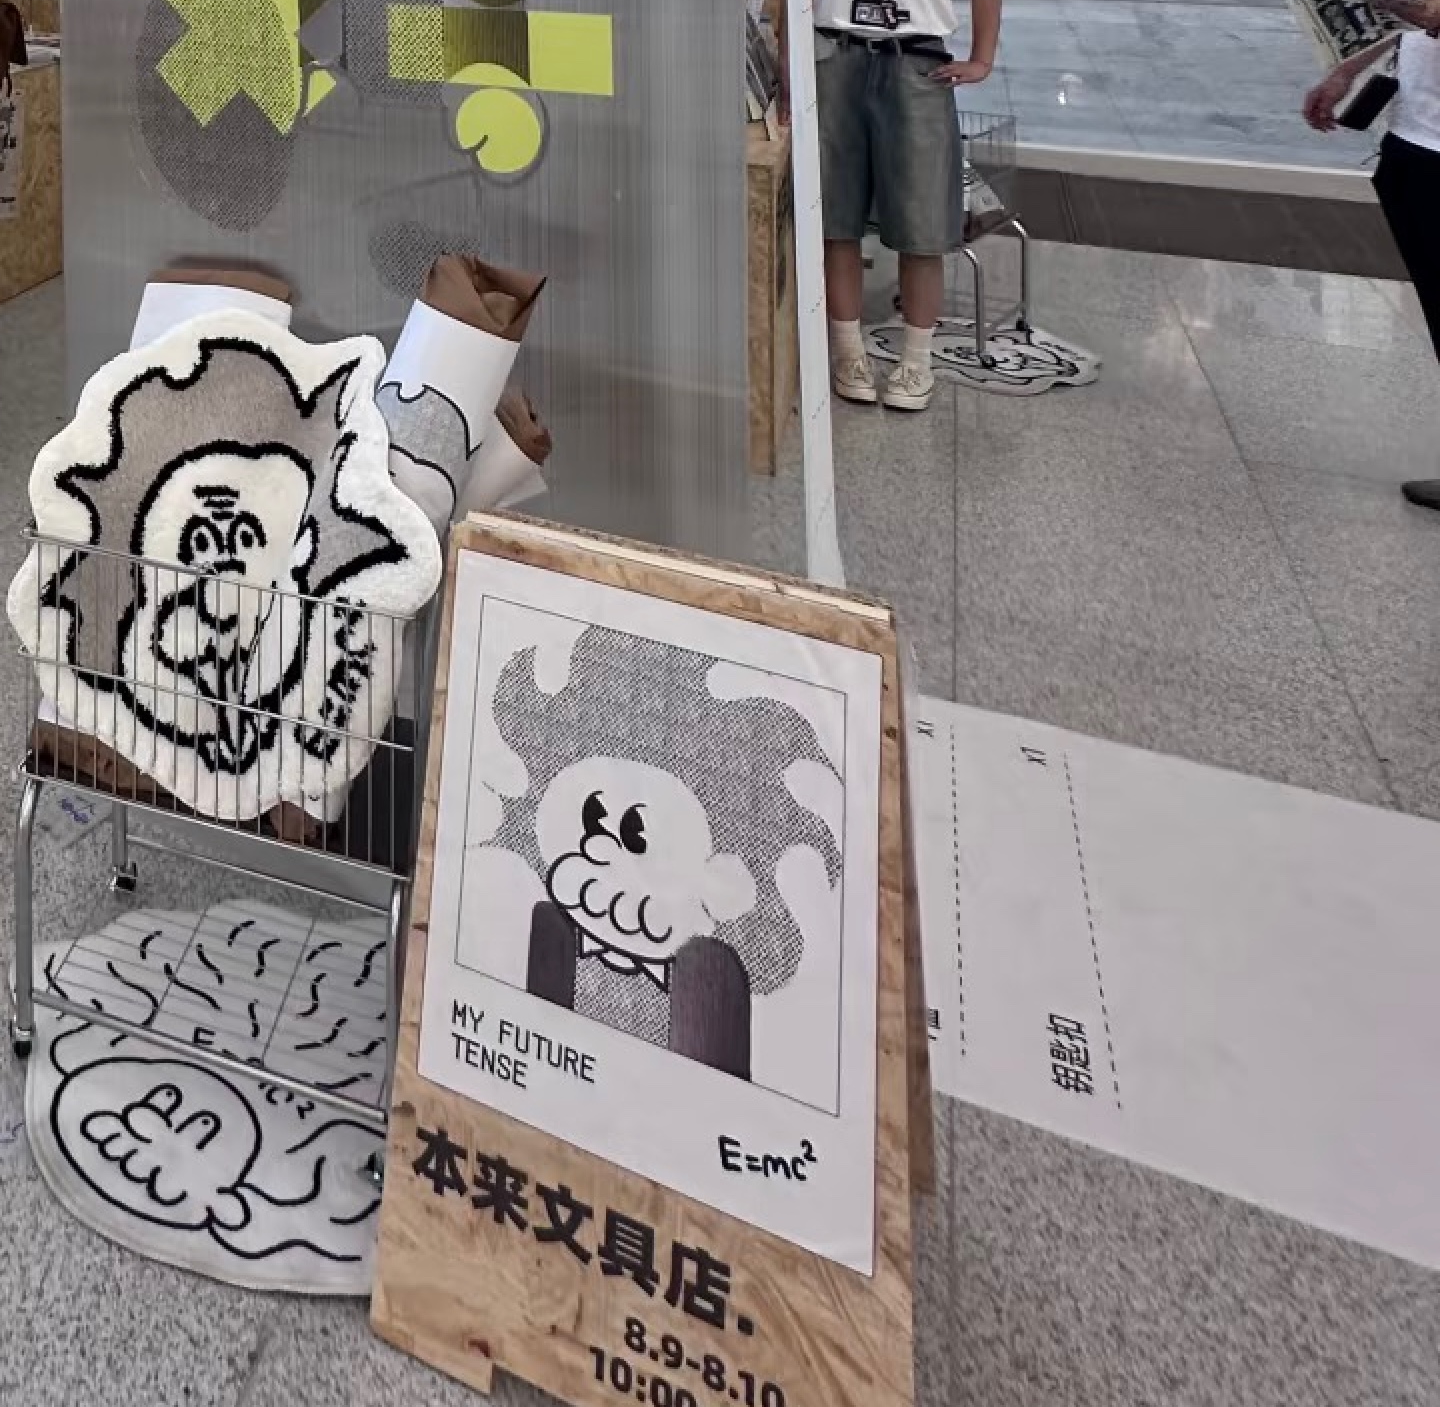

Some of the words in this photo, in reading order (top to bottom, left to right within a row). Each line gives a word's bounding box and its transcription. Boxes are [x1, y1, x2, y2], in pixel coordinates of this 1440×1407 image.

[451, 999, 485, 1034] MY
[499, 1019, 596, 1085] FUTURE
[451, 1032, 528, 1090] TENSE
[623, 1315, 786, 1407] 8.9-8.10
